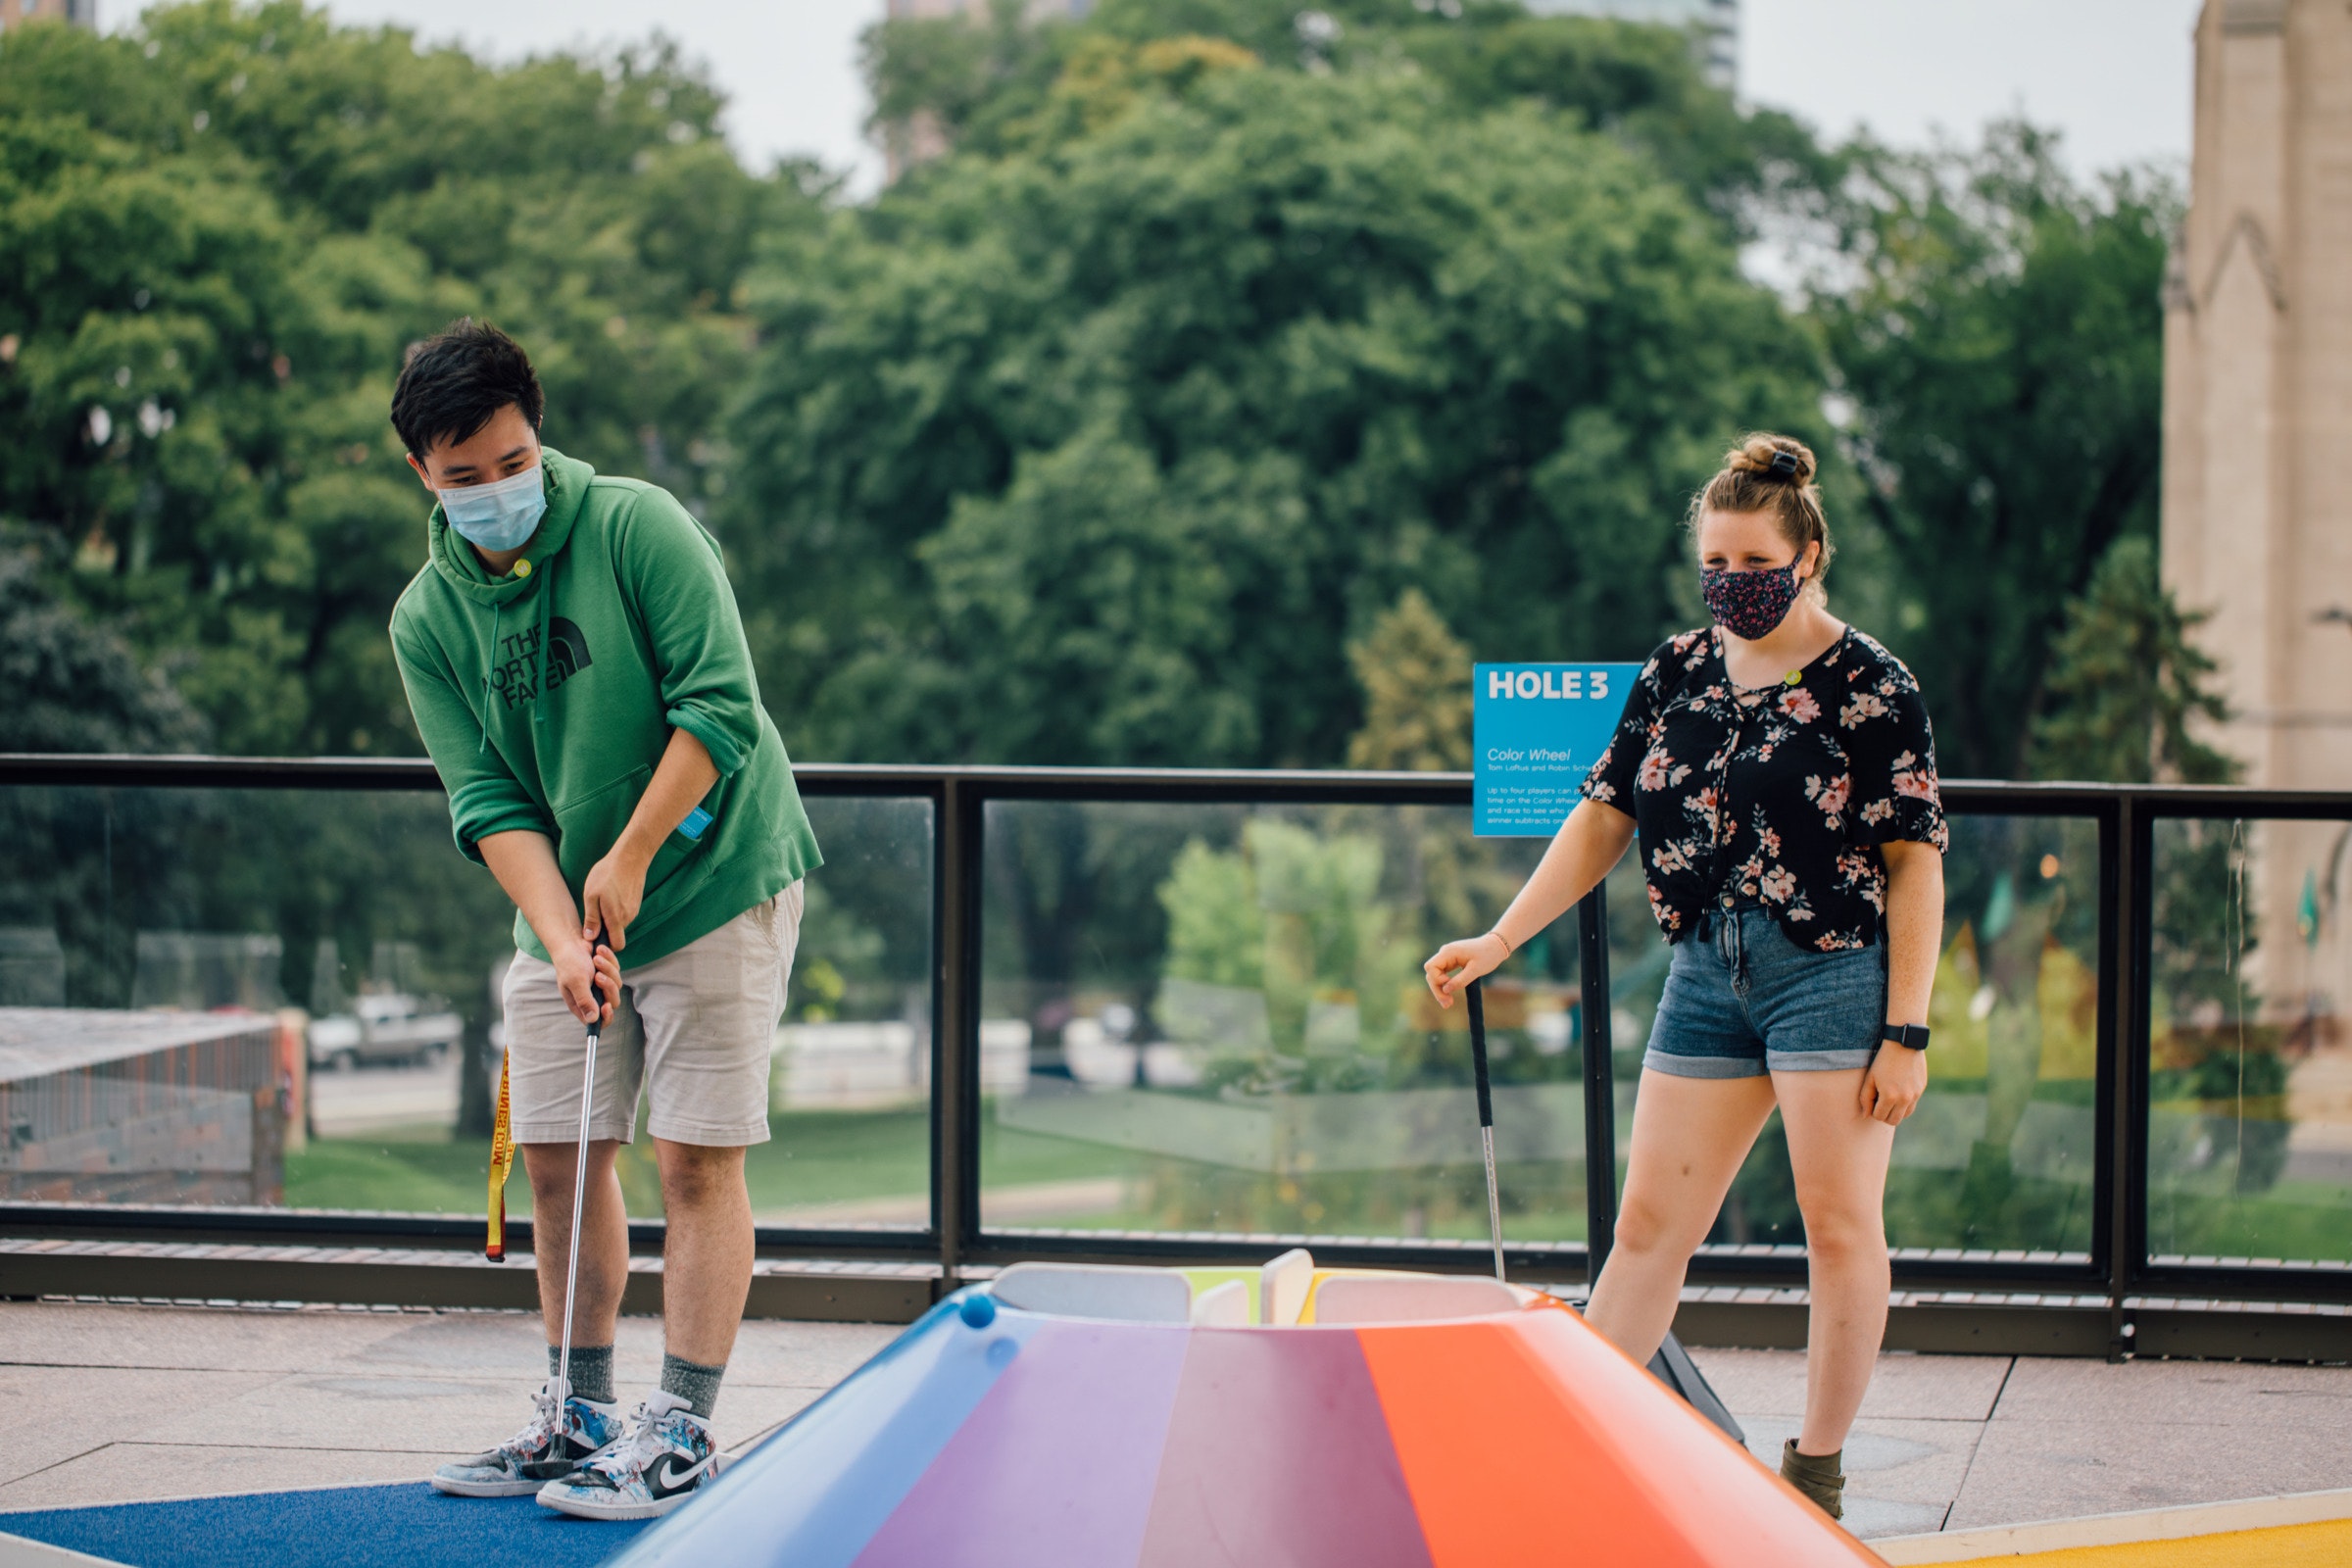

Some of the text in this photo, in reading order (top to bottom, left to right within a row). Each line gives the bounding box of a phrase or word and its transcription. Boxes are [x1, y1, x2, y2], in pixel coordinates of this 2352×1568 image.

[1489, 670, 1609, 700] HOLE 3
[1488, 748, 1571, 761] Color Wheel
